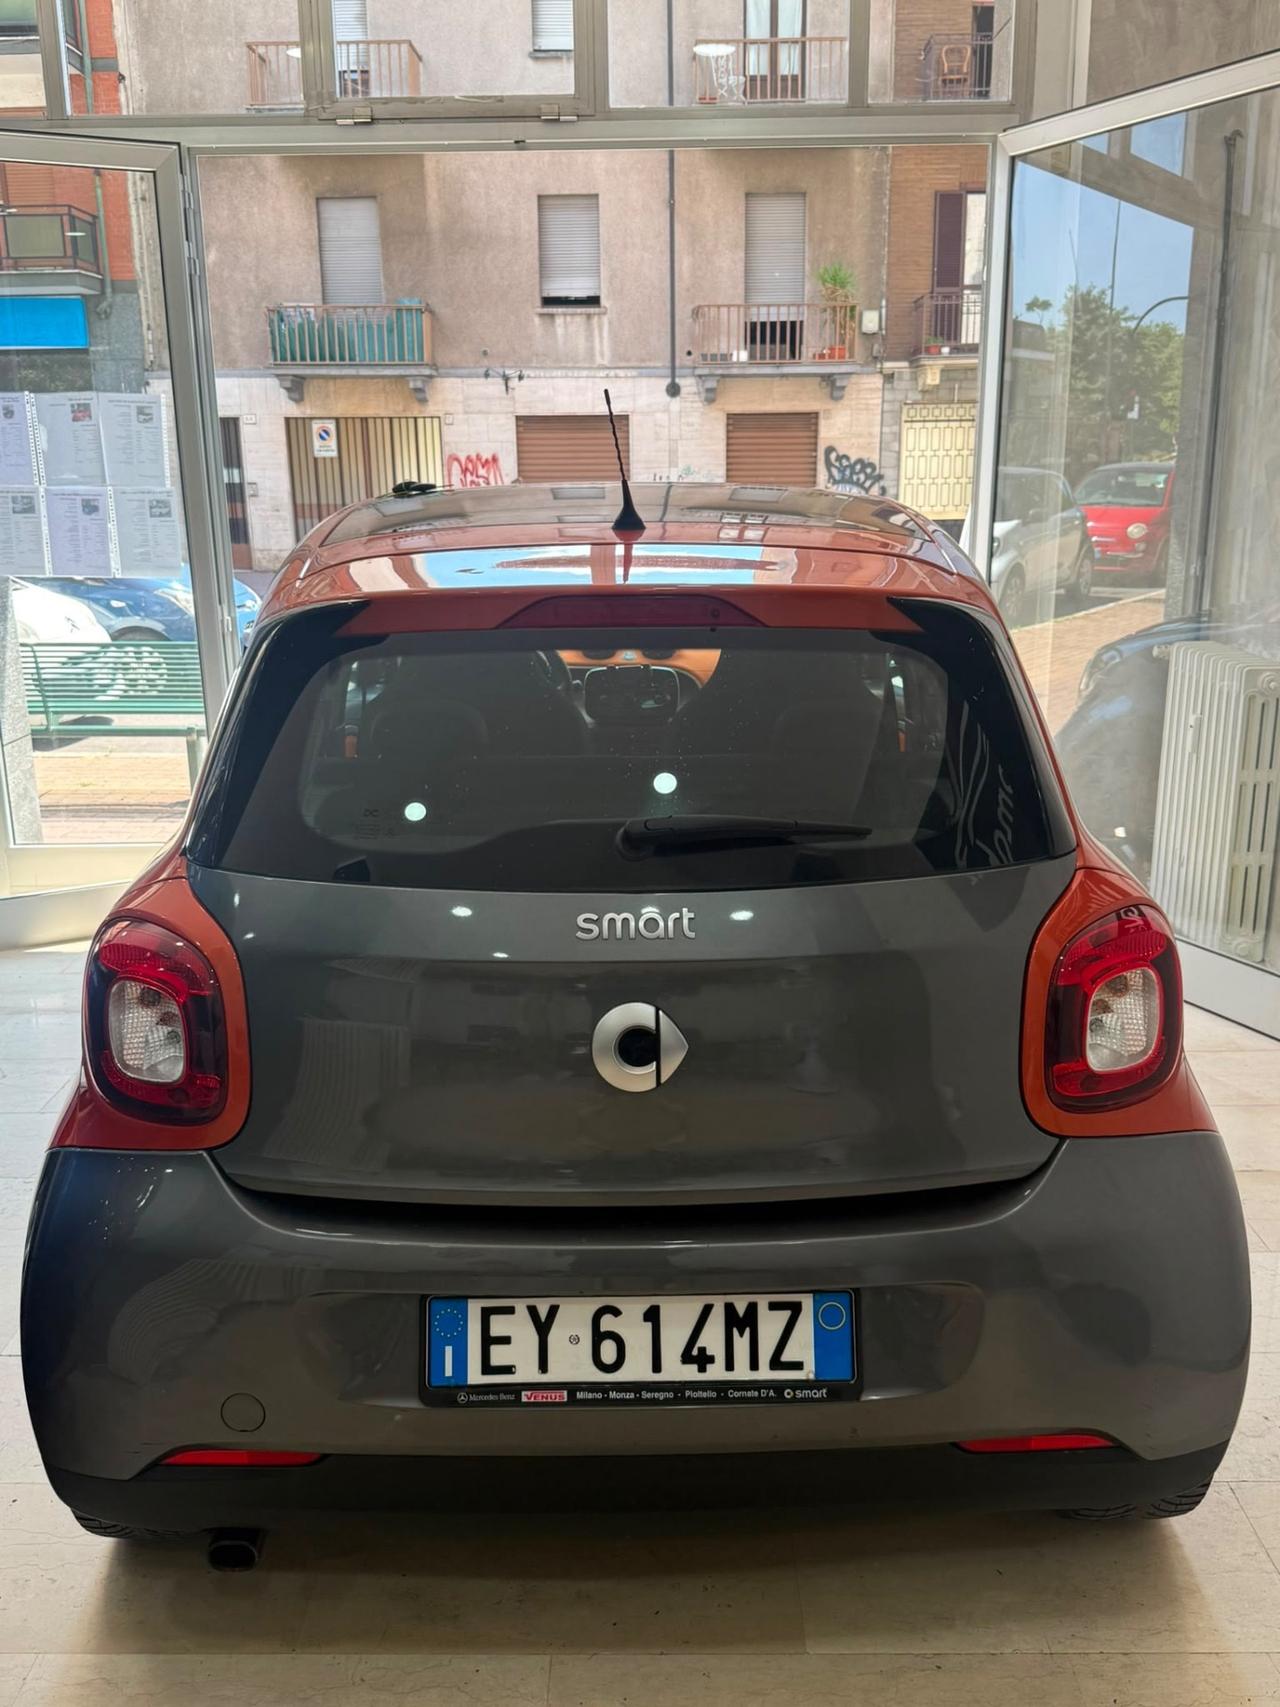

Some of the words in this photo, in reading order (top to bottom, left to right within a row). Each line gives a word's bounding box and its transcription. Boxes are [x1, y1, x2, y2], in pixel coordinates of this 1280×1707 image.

[576, 907, 696, 940] smart
[480, 1304, 560, 1376] EY
[591, 1301, 805, 1375] 614MZ
[444, 1345, 453, 1377] I
[524, 1391, 567, 1401] VENUS
[576, 1391, 603, 1399] Milano
[609, 1390, 635, 1399] Monza
[641, 1390, 674, 1400] Seregno
[728, 1389, 759, 1398] Cornate
[795, 1388, 828, 1398] smart
